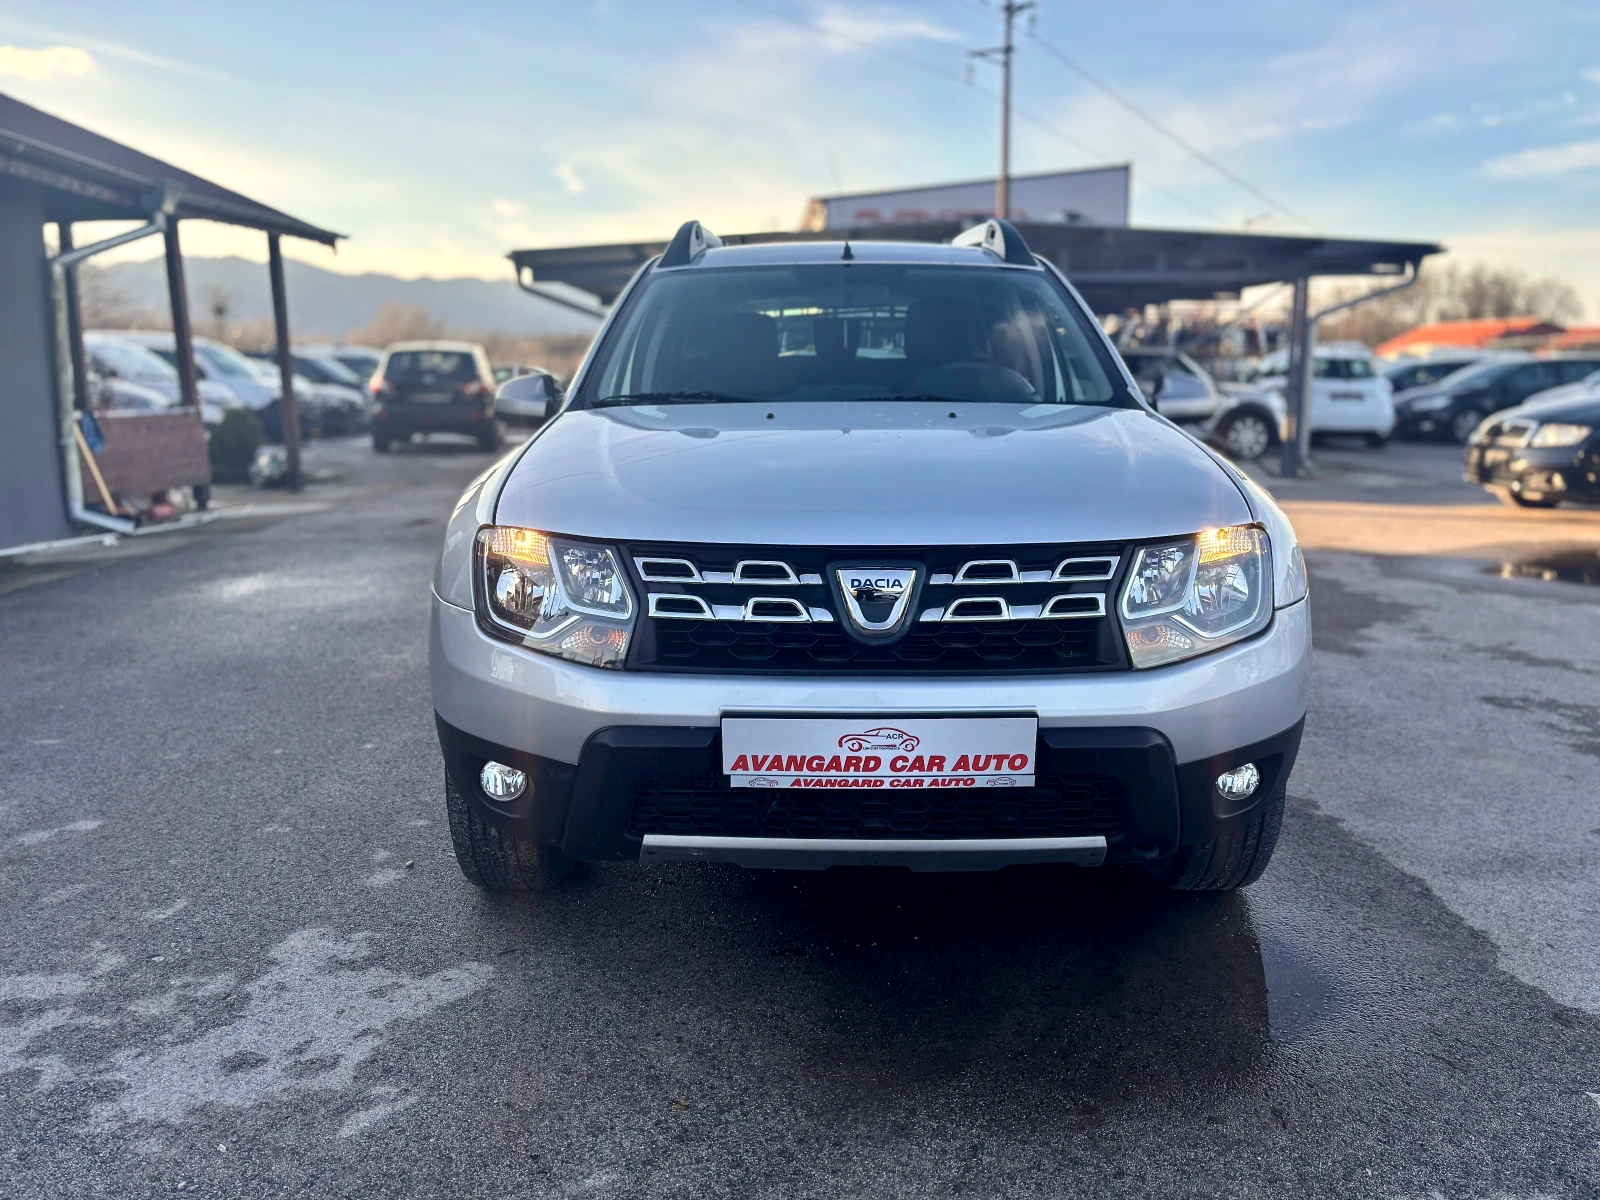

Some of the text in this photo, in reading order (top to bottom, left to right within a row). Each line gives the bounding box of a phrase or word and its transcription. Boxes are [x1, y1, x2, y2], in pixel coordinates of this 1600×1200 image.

[850, 578, 903, 589] DACIA
[730, 753, 1028, 773] AVANGARD CAR AUTO
[790, 778, 976, 788] AVANGARD CAR AUTO
